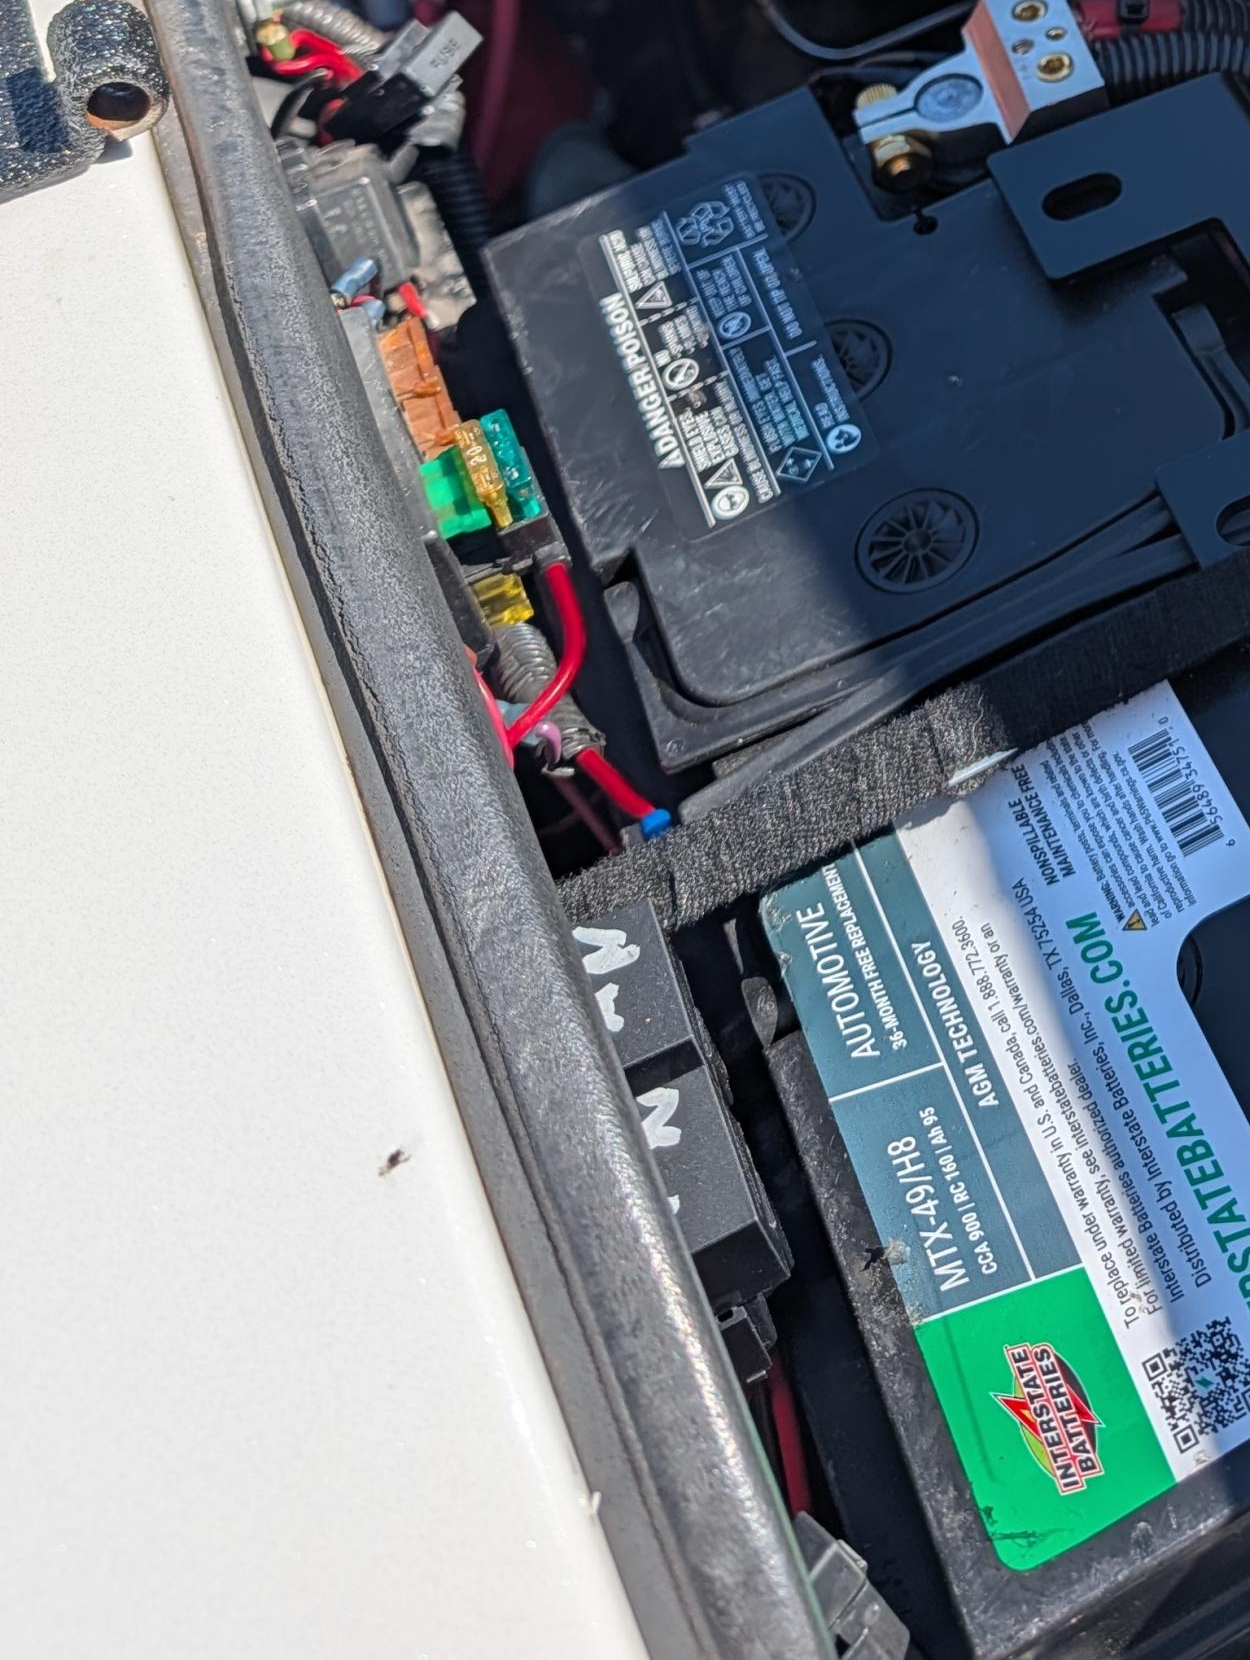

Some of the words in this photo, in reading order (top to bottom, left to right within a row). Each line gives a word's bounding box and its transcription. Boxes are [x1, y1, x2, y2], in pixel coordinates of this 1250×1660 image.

[429, 39, 463, 68] FUSE
[597, 289, 681, 457] DANGER/POISON
[1156, 715, 1169, 725] 0
[1042, 736, 1064, 767] includin
[1057, 735, 1073, 755] state
[1069, 730, 1087, 751] other
[1081, 748, 1091, 758] or
[1087, 737, 1101, 751] For
[1039, 758, 1058, 785] related
[1065, 752, 1079, 766] the
[1071, 763, 1083, 775] to
[1083, 756, 1104, 785] defects
[1093, 748, 1121, 784] handling.
[1167, 736, 1199, 780] 34751
[1009, 762, 1035, 794] FREE
[1050, 781, 1065, 798] and
[1056, 763, 1082, 801] chemicals
[1075, 771, 1095, 798] known
[1096, 783, 1113, 802] birth
[1110, 780, 1127, 801] after
[1057, 795, 1082, 832] terminals
[1073, 798, 1086, 810] to
[1080, 805, 1095, 823] you
[1089, 795, 1101, 809] are
[1105, 800, 1120, 817] and
[1119, 798, 1139, 824] hands
[1190, 780, 1223, 825] 56489
[1023, 790, 1076, 879] MAINTENANCE
[1087, 819, 1109, 849] expose
[1093, 808, 1113, 833] which
[1115, 814, 1133, 841] cancer
[1131, 821, 1150, 845] Wash
[1007, 796, 1060, 886] NONSPILLABLE
[1073, 828, 1095, 855] posts,
[1100, 847, 1114, 864] can
[1104, 829, 1137, 876] compounds,
[1127, 840, 1145, 864] cause
[1142, 842, 1161, 867] harm.
[1156, 841, 1169, 853] to
[1163, 849, 1177, 862] go
[1224, 837, 1237, 848] 6
[1085, 851, 1109, 882] Battery
[1136, 862, 1149, 874] to
[1008, 876, 1035, 908] USA
[1106, 862, 1136, 909] accessories
[1127, 874, 1144, 894] lead
[1141, 871, 1168, 910] California
[1153, 863, 1188, 914] reproductive
[1167, 861, 1197, 907] information
[820, 861, 867, 949] REPLACEMENT
[1098, 879, 1126, 922] WARNING:
[1136, 891, 1151, 909] and
[1160, 908, 1173, 920] of
[978, 922, 995, 940] an
[1021, 905, 1054, 950] 75254
[1143, 906, 1160, 927] lead
[985, 938, 1001, 954] or
[1040, 945, 1064, 970] TX
[854, 945, 880, 980] FREE
[947, 914, 1002, 1012] 1.888.772.3600.
[794, 899, 882, 1066] AUTOMOTIVE
[1050, 964, 1088, 1016] Dallas,
[867, 976, 909, 1051] 36-MONTH
[909, 935, 979, 1063] TECHNOLOGY
[989, 1008, 1012, 1035] call
[1071, 1010, 1102, 1045] Inc.,
[988, 950, 1093, 1151] interstatebatteries.com/warranty
[999, 1031, 1037, 1086] Canada,
[963, 1060, 1000, 1112] AGM
[1061, 1056, 1094, 1103] dealer.
[1085, 1039, 1133, 1111] Batteries,
[1021, 1083, 1045, 1111] and
[918, 1104, 938, 1127] 95
[1033, 1108, 1058, 1139] U.S.
[925, 1123, 947, 1148] Ah
[1045, 1136, 1064, 1154] in
[1081, 1100, 1125, 1173] authorized
[1116, 1108, 1163, 1181] Interstate
[937, 1152, 960, 1181] 160
[1080, 1147, 1101, 1175] see
[948, 1179, 970, 1205] RC
[1051, 1149, 1094, 1212] warranty
[1149, 1176, 1177, 1202] by
[884, 1132, 971, 1294] MTX-49/H8
[1088, 1172, 1133, 1240] warranty,
[1112, 1169, 1154, 1234] Batteries
[960, 1209, 985, 1242] 900
[1077, 1209, 1108, 1253] under
[972, 1240, 999, 1276] CCA
[1159, 1199, 1213, 1288] Distributed
[1095, 1248, 1135, 1307] replace
[1116, 1236, 1151, 1289] limited
[1141, 1231, 1185, 1303] Interstate
[1139, 1286, 1163, 1315] For
[1119, 1304, 1141, 1329] To
[1009, 1345, 1081, 1492] INTERSTATE
[1032, 1344, 1097, 1475] BATTERIES
